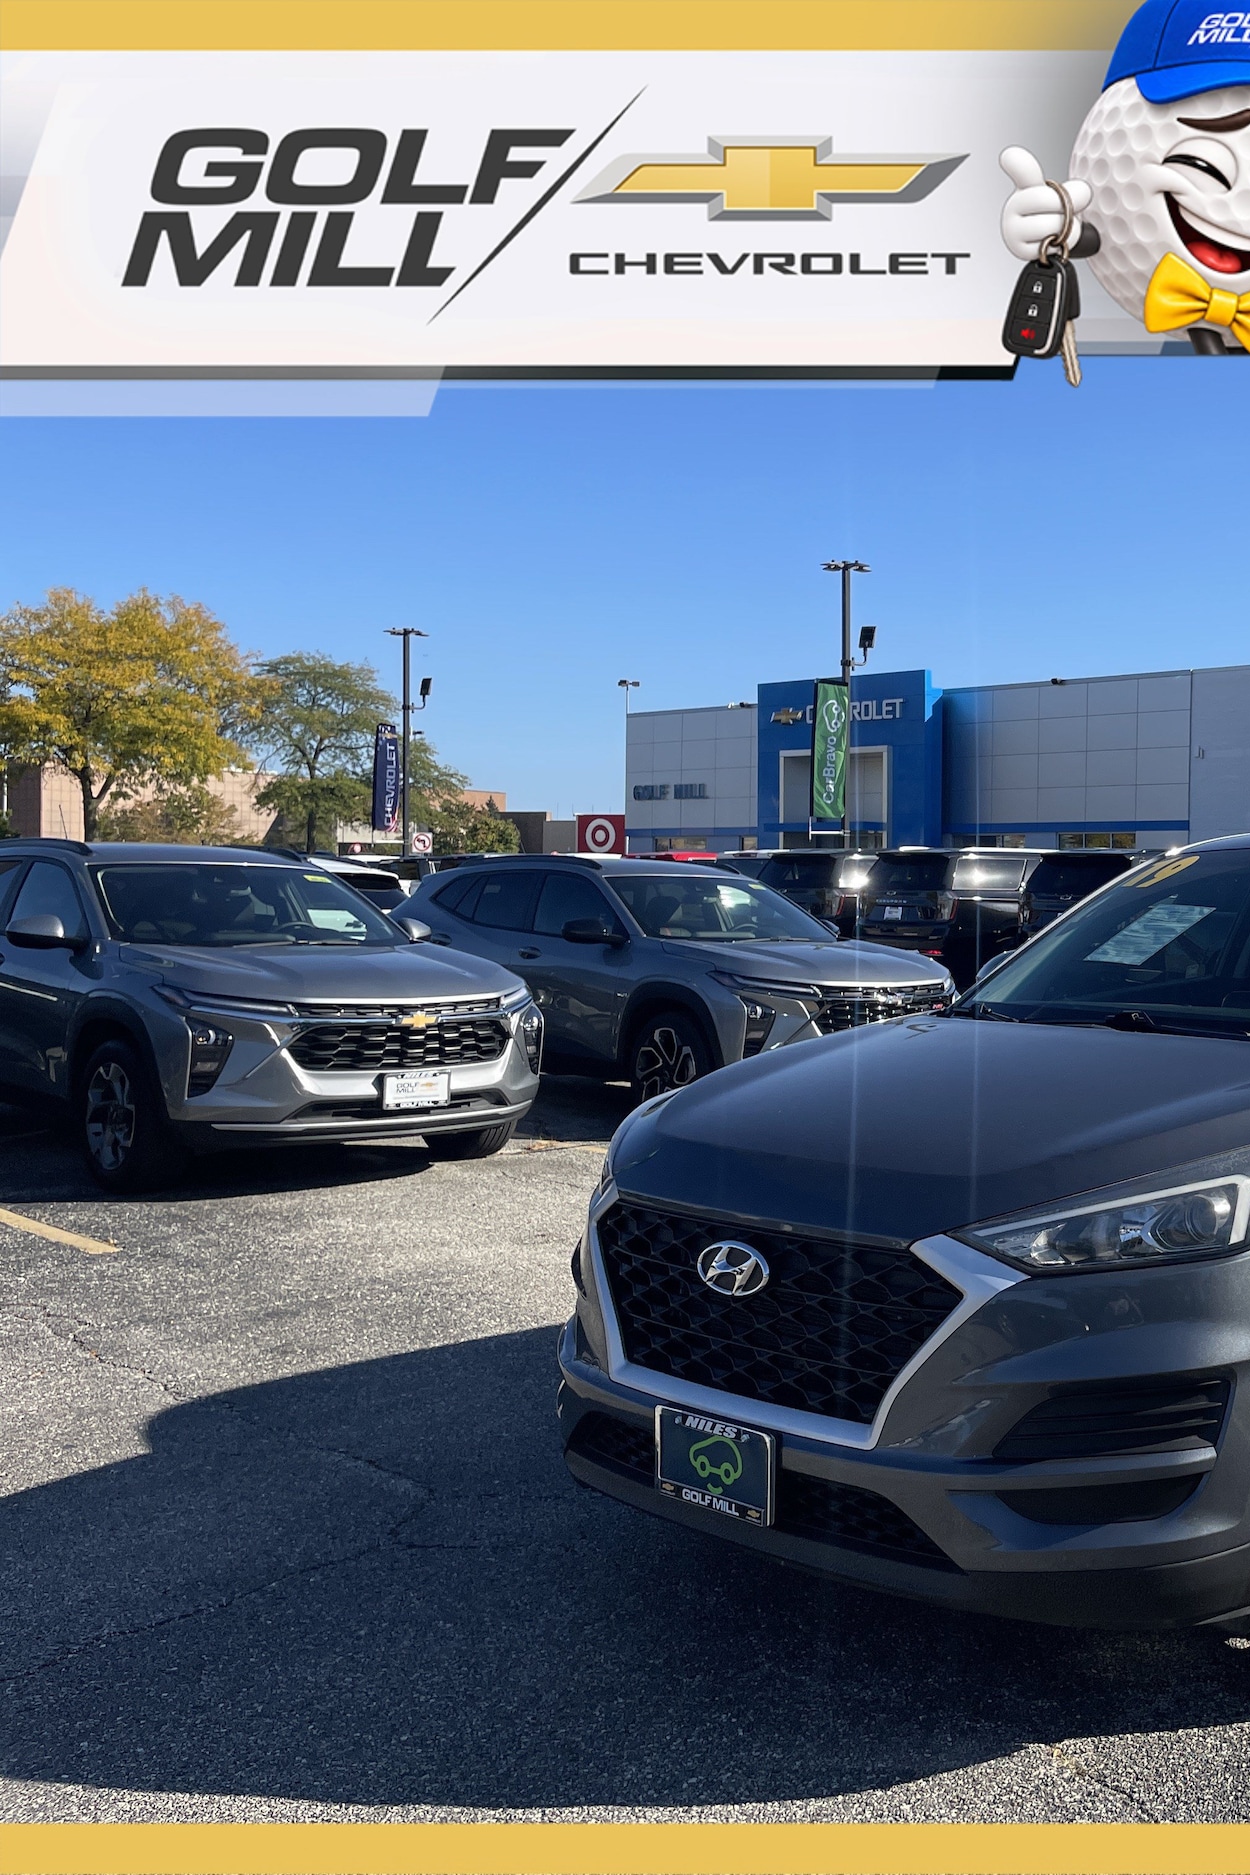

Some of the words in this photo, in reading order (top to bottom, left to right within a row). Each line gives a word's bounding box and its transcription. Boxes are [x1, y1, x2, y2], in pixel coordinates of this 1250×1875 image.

[805, 698, 904, 725] CROLET
[384, 742, 397, 826] CHEVROLET
[822, 736, 837, 804] CarBravo
[633, 784, 669, 801] GOLF
[673, 783, 708, 800] MILL
[685, 1415, 738, 1439] NILES
[681, 1488, 712, 1507] GOLF
[712, 1499, 740, 1517] MILL
